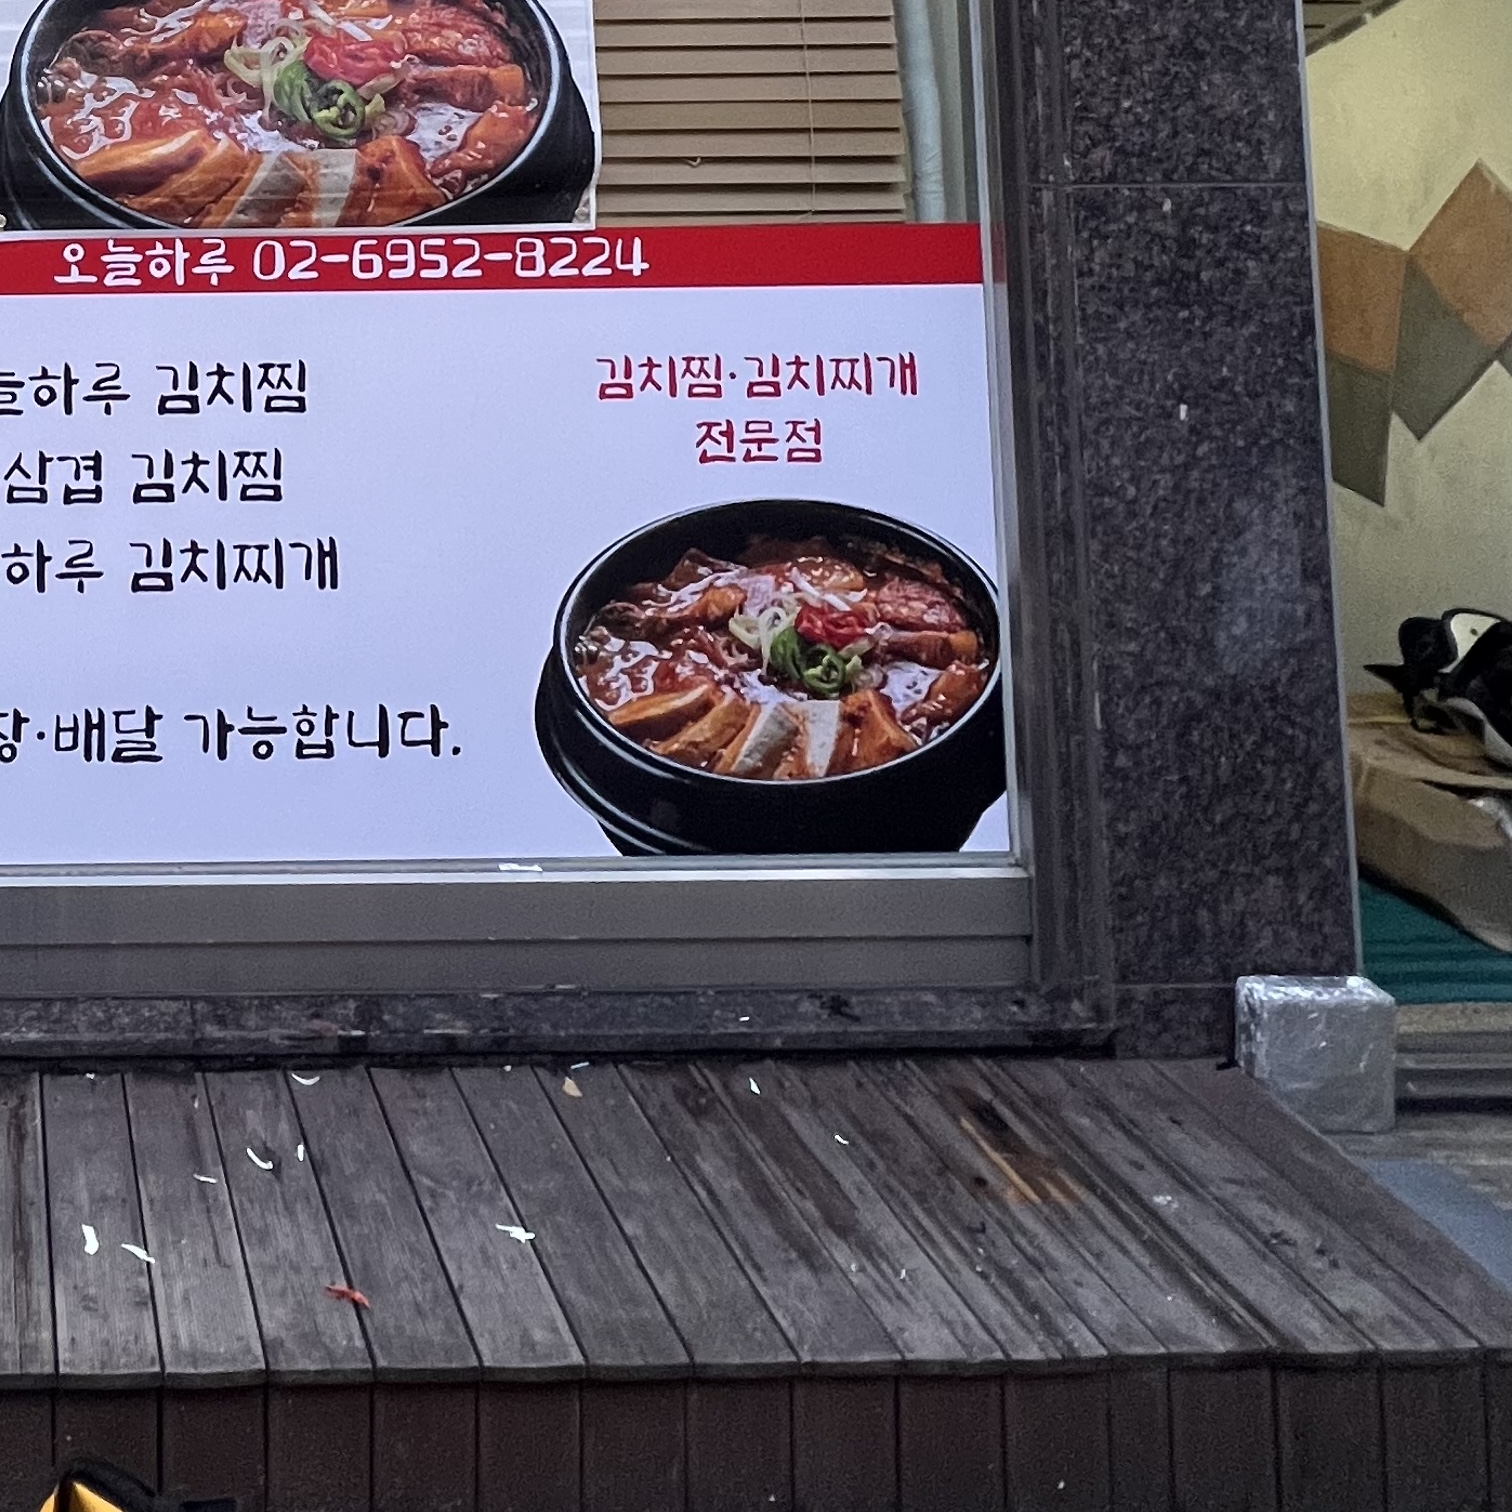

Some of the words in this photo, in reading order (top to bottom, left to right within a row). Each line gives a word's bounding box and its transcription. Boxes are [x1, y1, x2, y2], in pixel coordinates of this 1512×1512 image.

[53, 239, 235, 286] 오늘하루
[252, 235, 650, 281] 02-6952-8224
[155, 359, 307, 415] 김치찜
[597, 352, 918, 401] 김치찜·김치찌개
[696, 419, 823, 465] 전문점
[131, 447, 283, 504] 김치찜
[129, 536, 339, 593] 김치찌개
[183, 703, 461, 762] 가능합니다.
